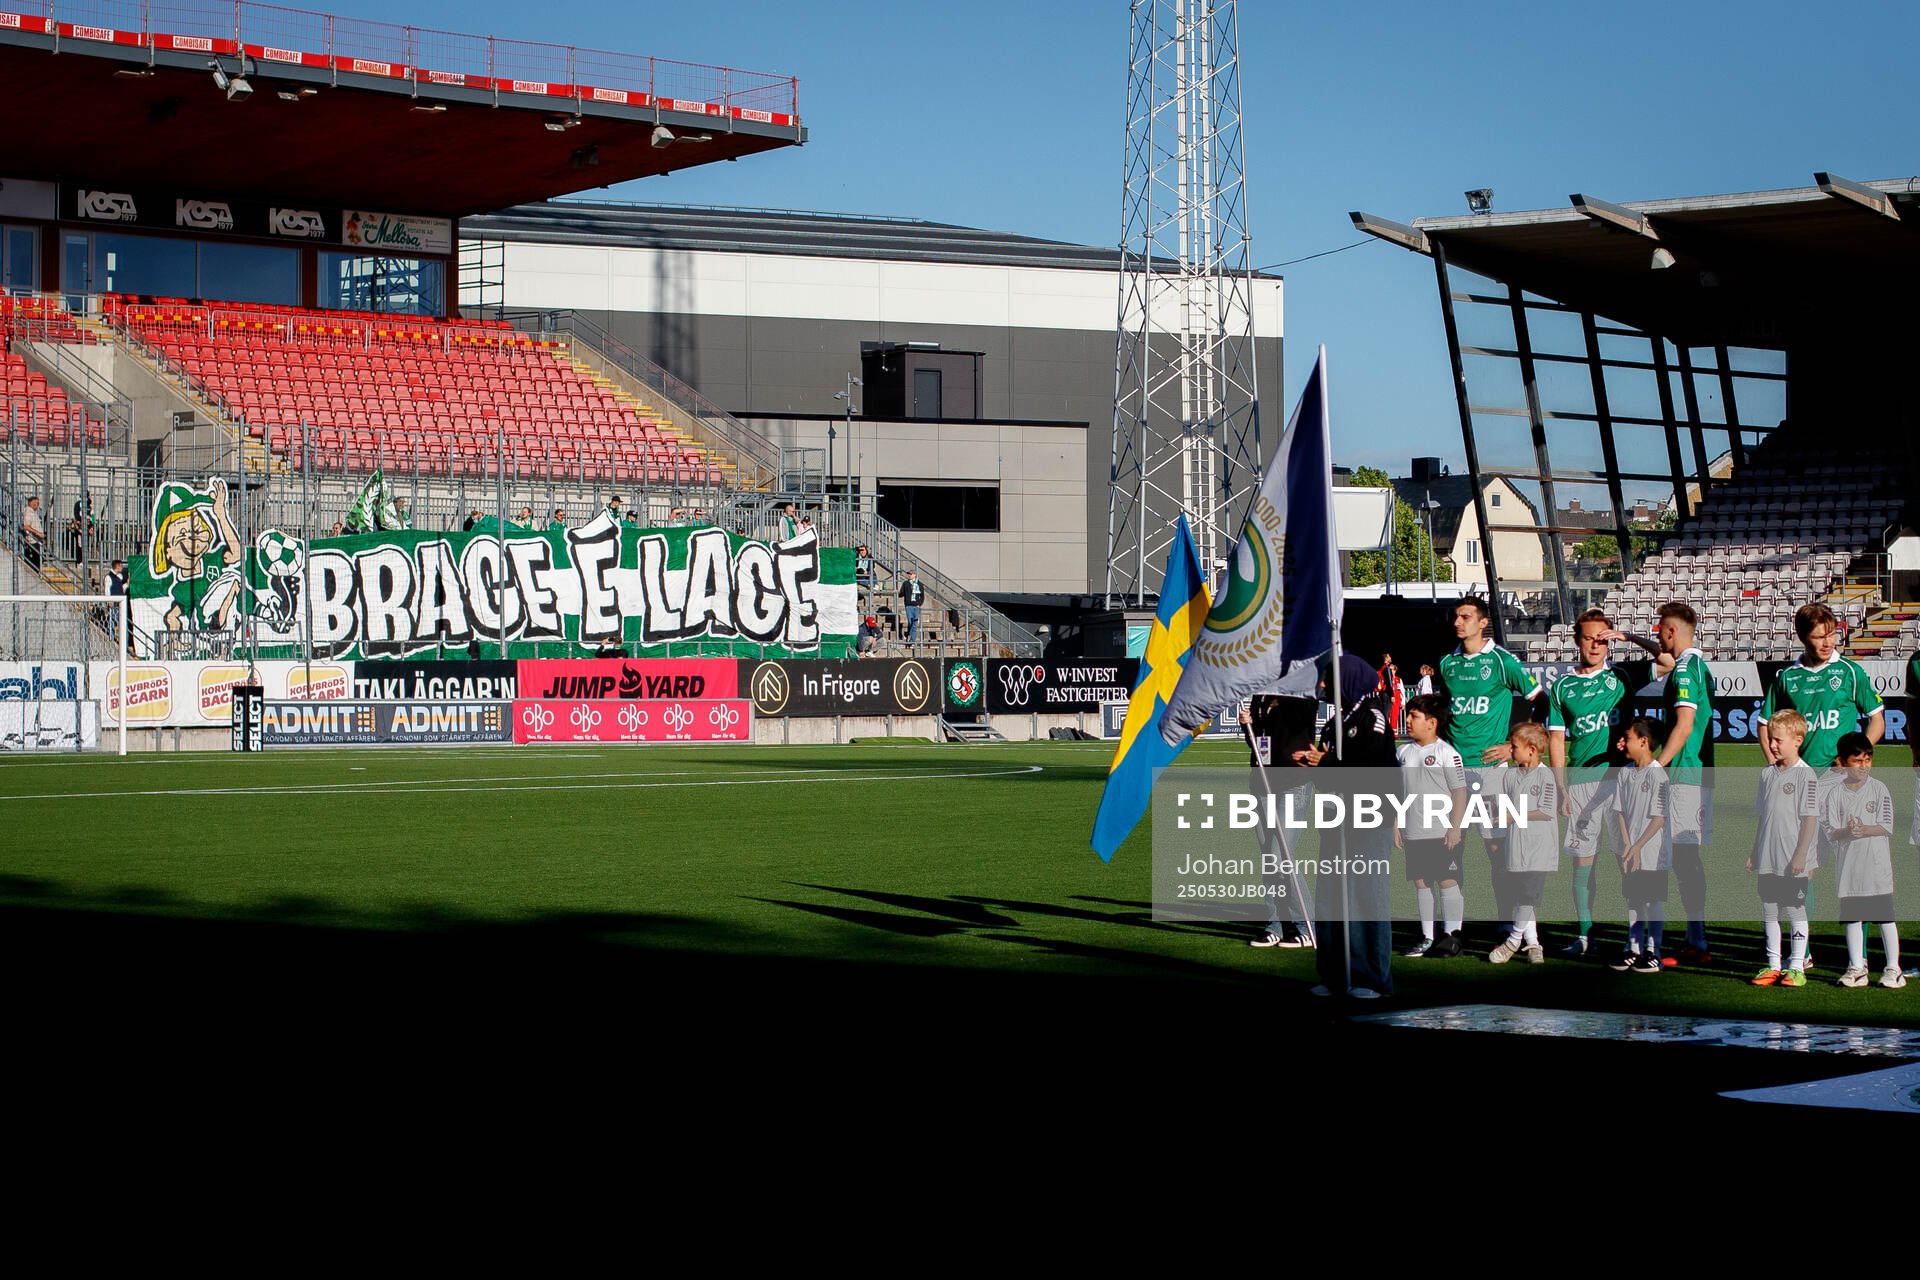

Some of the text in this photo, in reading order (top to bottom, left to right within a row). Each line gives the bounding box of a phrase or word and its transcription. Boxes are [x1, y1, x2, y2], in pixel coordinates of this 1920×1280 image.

[75, 26, 111, 40] COMBISAFE
[174, 36, 212, 51] COMBISAFE
[265, 48, 301, 62] COMBISAFE
[354, 60, 390, 75] COMBISAFE
[430, 72, 462, 85] COMBISAFE
[513, 81, 546, 94] COMBISAFE
[594, 89, 627, 103] COMBISAFE
[675, 100, 704, 113] COMBISAFE
[741, 109, 770, 122] COMBISAFE
[307, 535, 565, 660] BRAGE
[543, 675, 705, 698] JUMP YARD
[803, 673, 880, 702] In Frigore
[1046, 687, 1129, 702] FASTIGHETER
[234, 695, 243, 751] SELECT
[249, 695, 262, 751] SELECT
[263, 706, 355, 733] ADMIT
[391, 706, 482, 733] ADMIT
[522, 703, 555, 733] ÖBO
[570, 703, 602, 733] ÖBO
[617, 703, 649, 733] ÖBO
[663, 703, 694, 732] ÖBO
[709, 703, 739, 732] ÖBO
